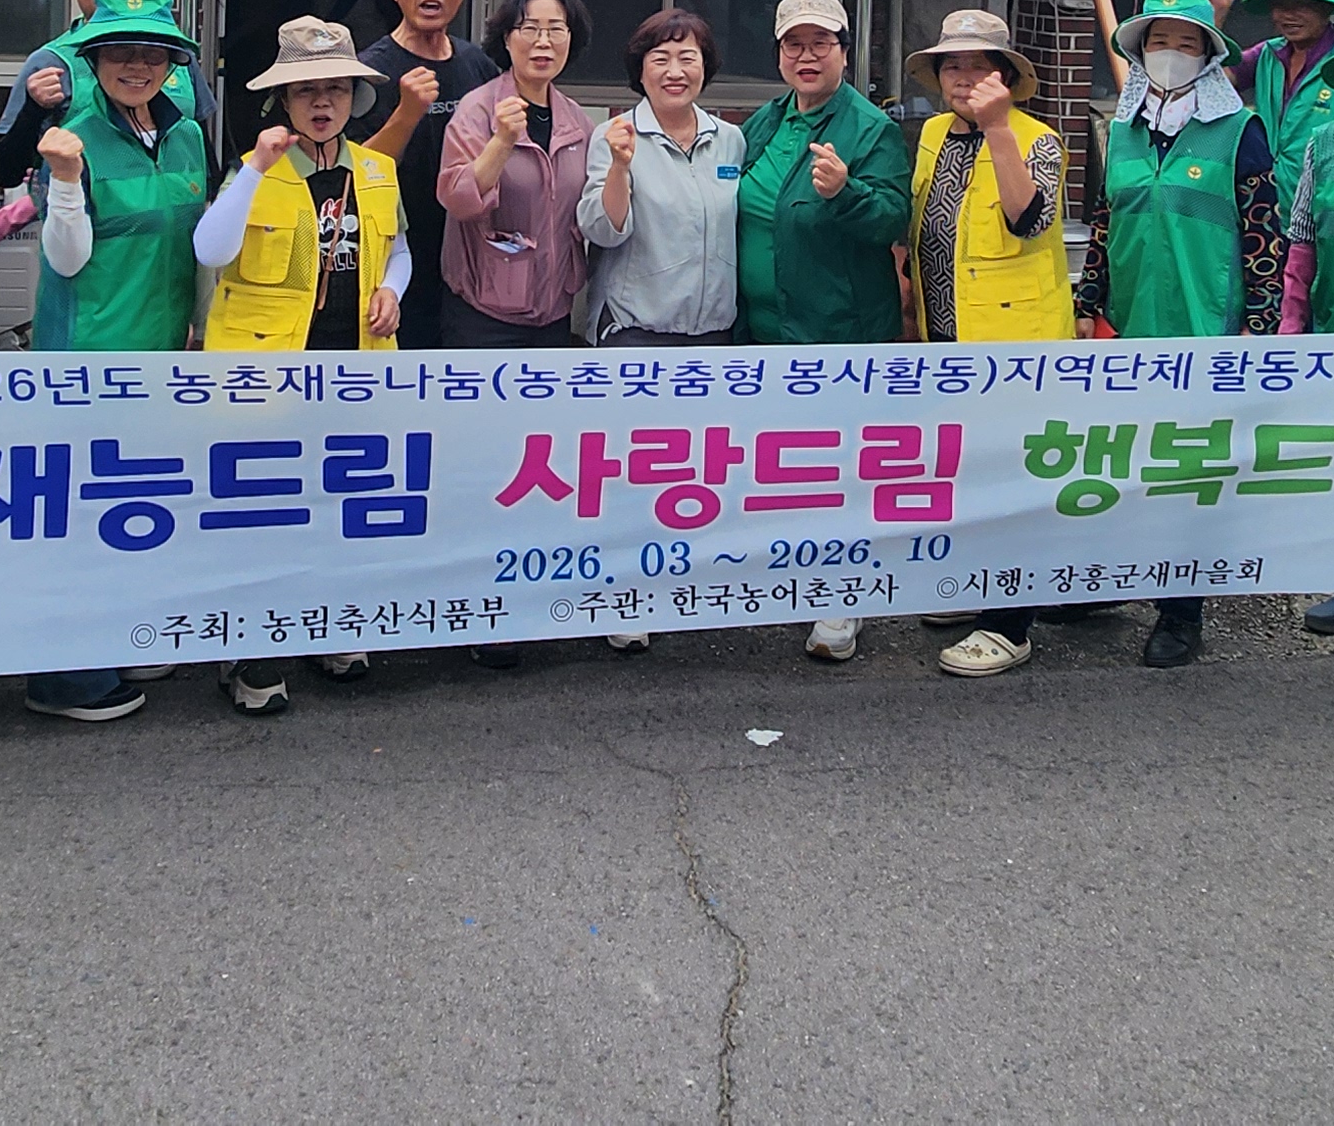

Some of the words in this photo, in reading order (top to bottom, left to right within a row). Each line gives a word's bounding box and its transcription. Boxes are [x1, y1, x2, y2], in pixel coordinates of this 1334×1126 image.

[167, 360, 765, 405] 농촌재능나눔(농촌맞춤형
[783, 352, 1193, 395] 봉사활동)지역단체
[495, 424, 962, 529] 사랑드림
[495, 545, 615, 585] 2026.
[641, 541, 692, 577] 03
[768, 539, 882, 570] 2026.
[906, 533, 951, 562] 10
[263, 597, 510, 644] 농림축산식품부
[670, 574, 900, 613] 한국농어촌공사
[1048, 558, 1265, 594] 장흥군새마을회
